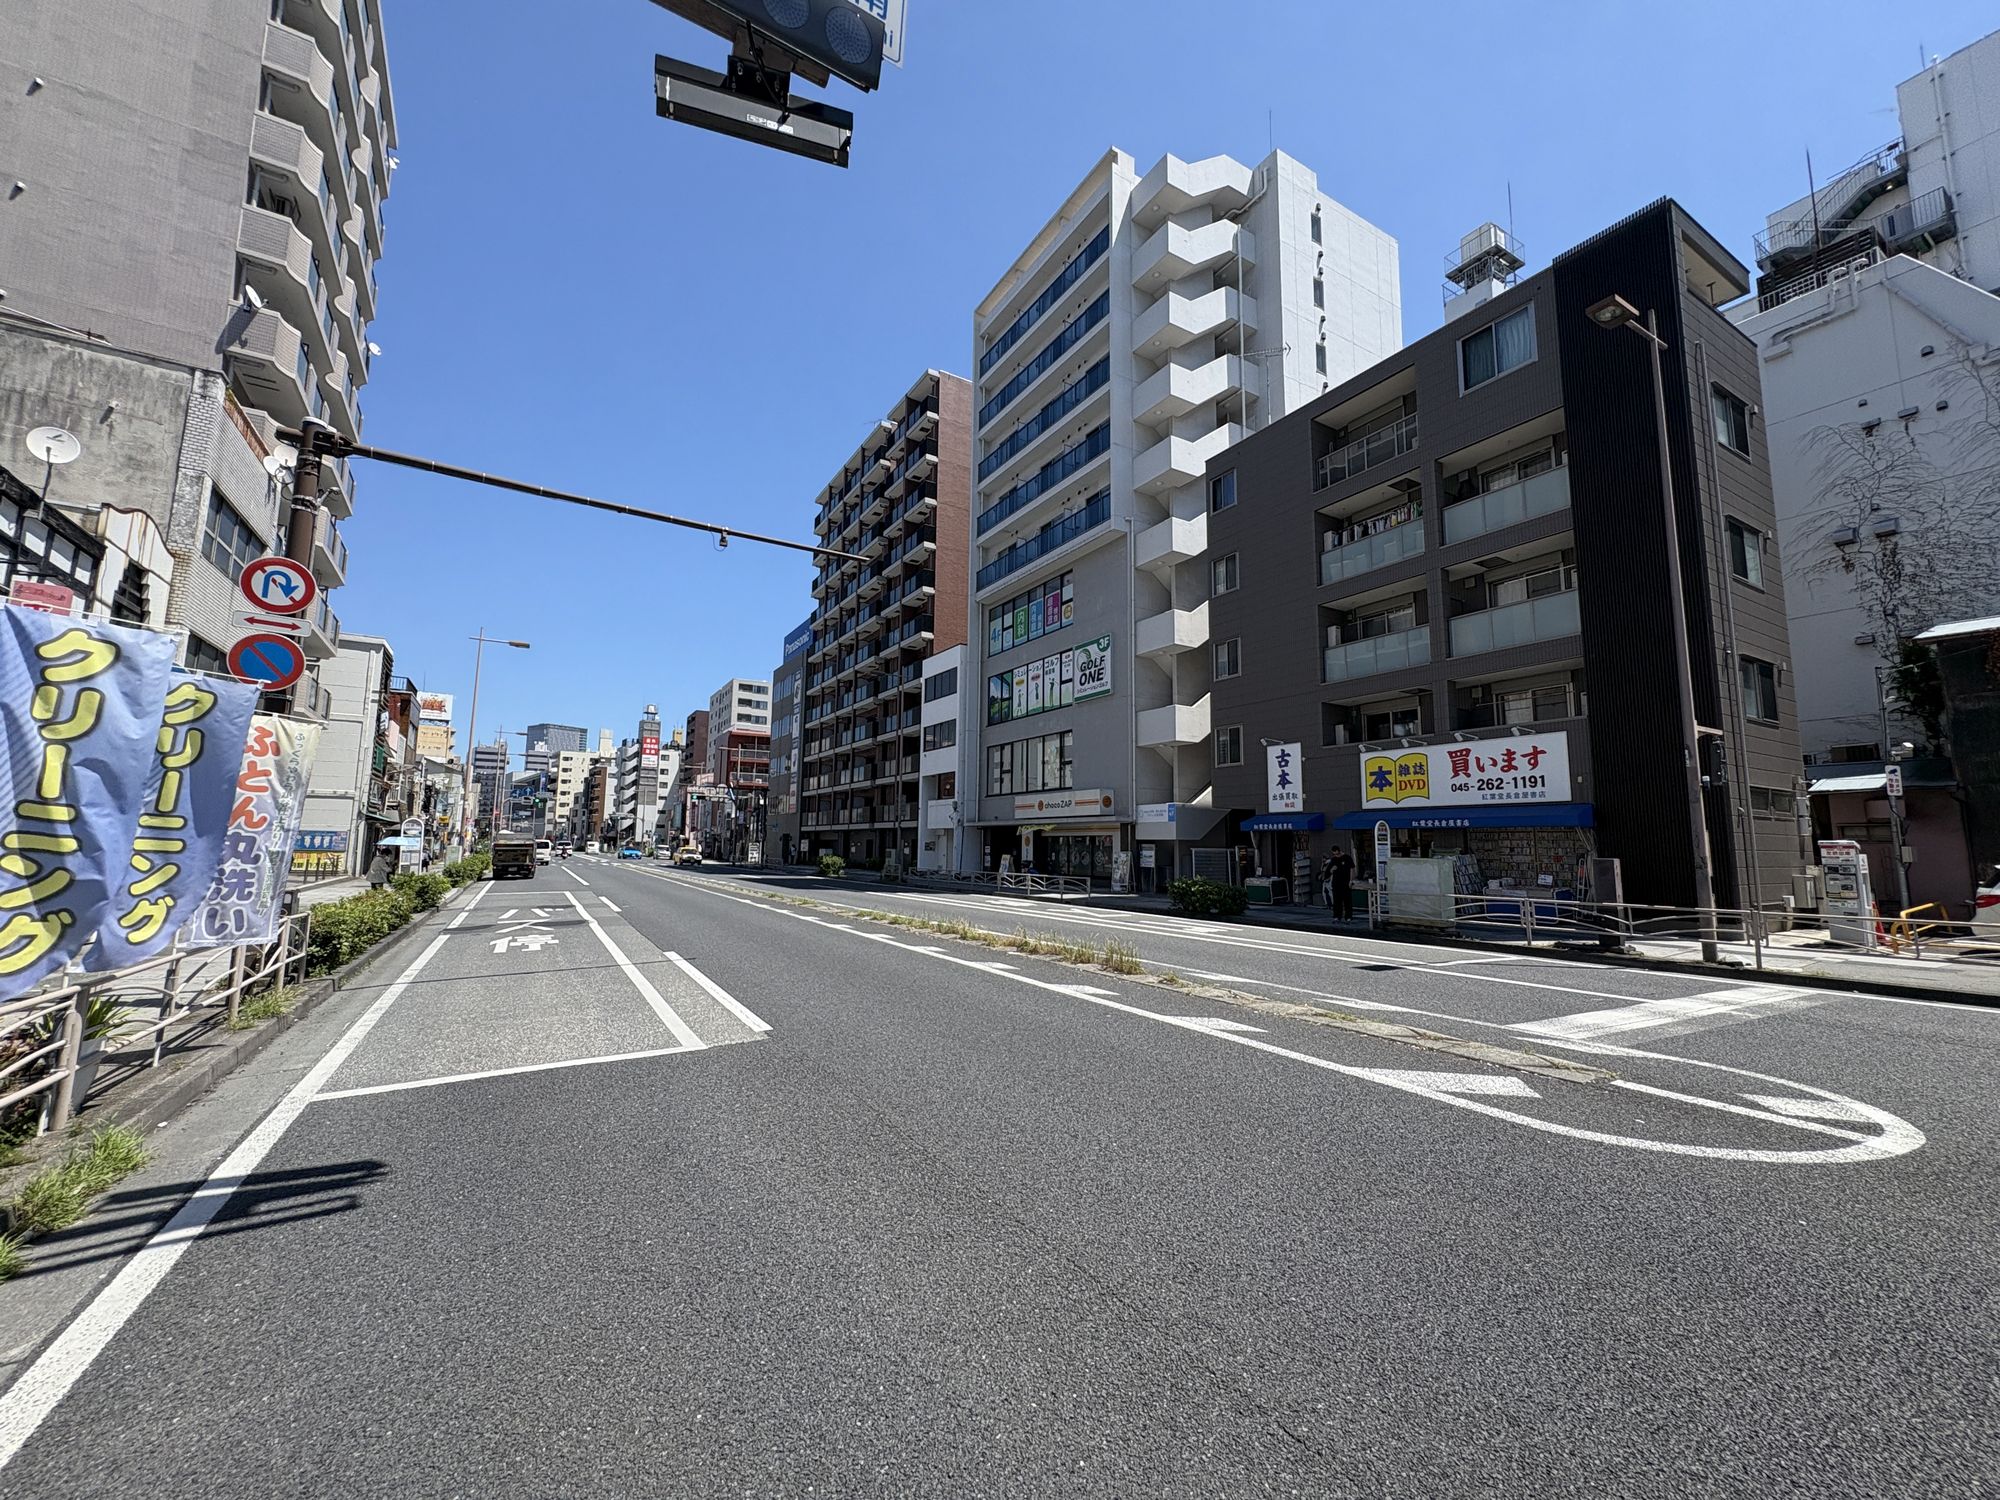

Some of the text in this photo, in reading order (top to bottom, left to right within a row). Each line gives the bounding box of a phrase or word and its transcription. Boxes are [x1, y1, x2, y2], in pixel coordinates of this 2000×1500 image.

[1017, 611, 1025, 638] 内科
[785, 630, 810, 657] Panasonic
[1098, 636, 1110, 648] 3F
[1079, 667, 1105, 687] ONE
[1080, 655, 1106, 673] GOLF
[1275, 748, 1293, 790] 古本
[1447, 745, 1548, 779] 買います
[1368, 765, 1394, 792] 本
[1398, 778, 1426, 791] DVD
[1451, 774, 1546, 793] 045-262-1191
[0, 627, 120, 977] クリーニング
[117, 681, 218, 945] クリーニング
[1044, 799, 1072, 809] chocoZAP
[203, 725, 281, 938] ふとん丸洗い
